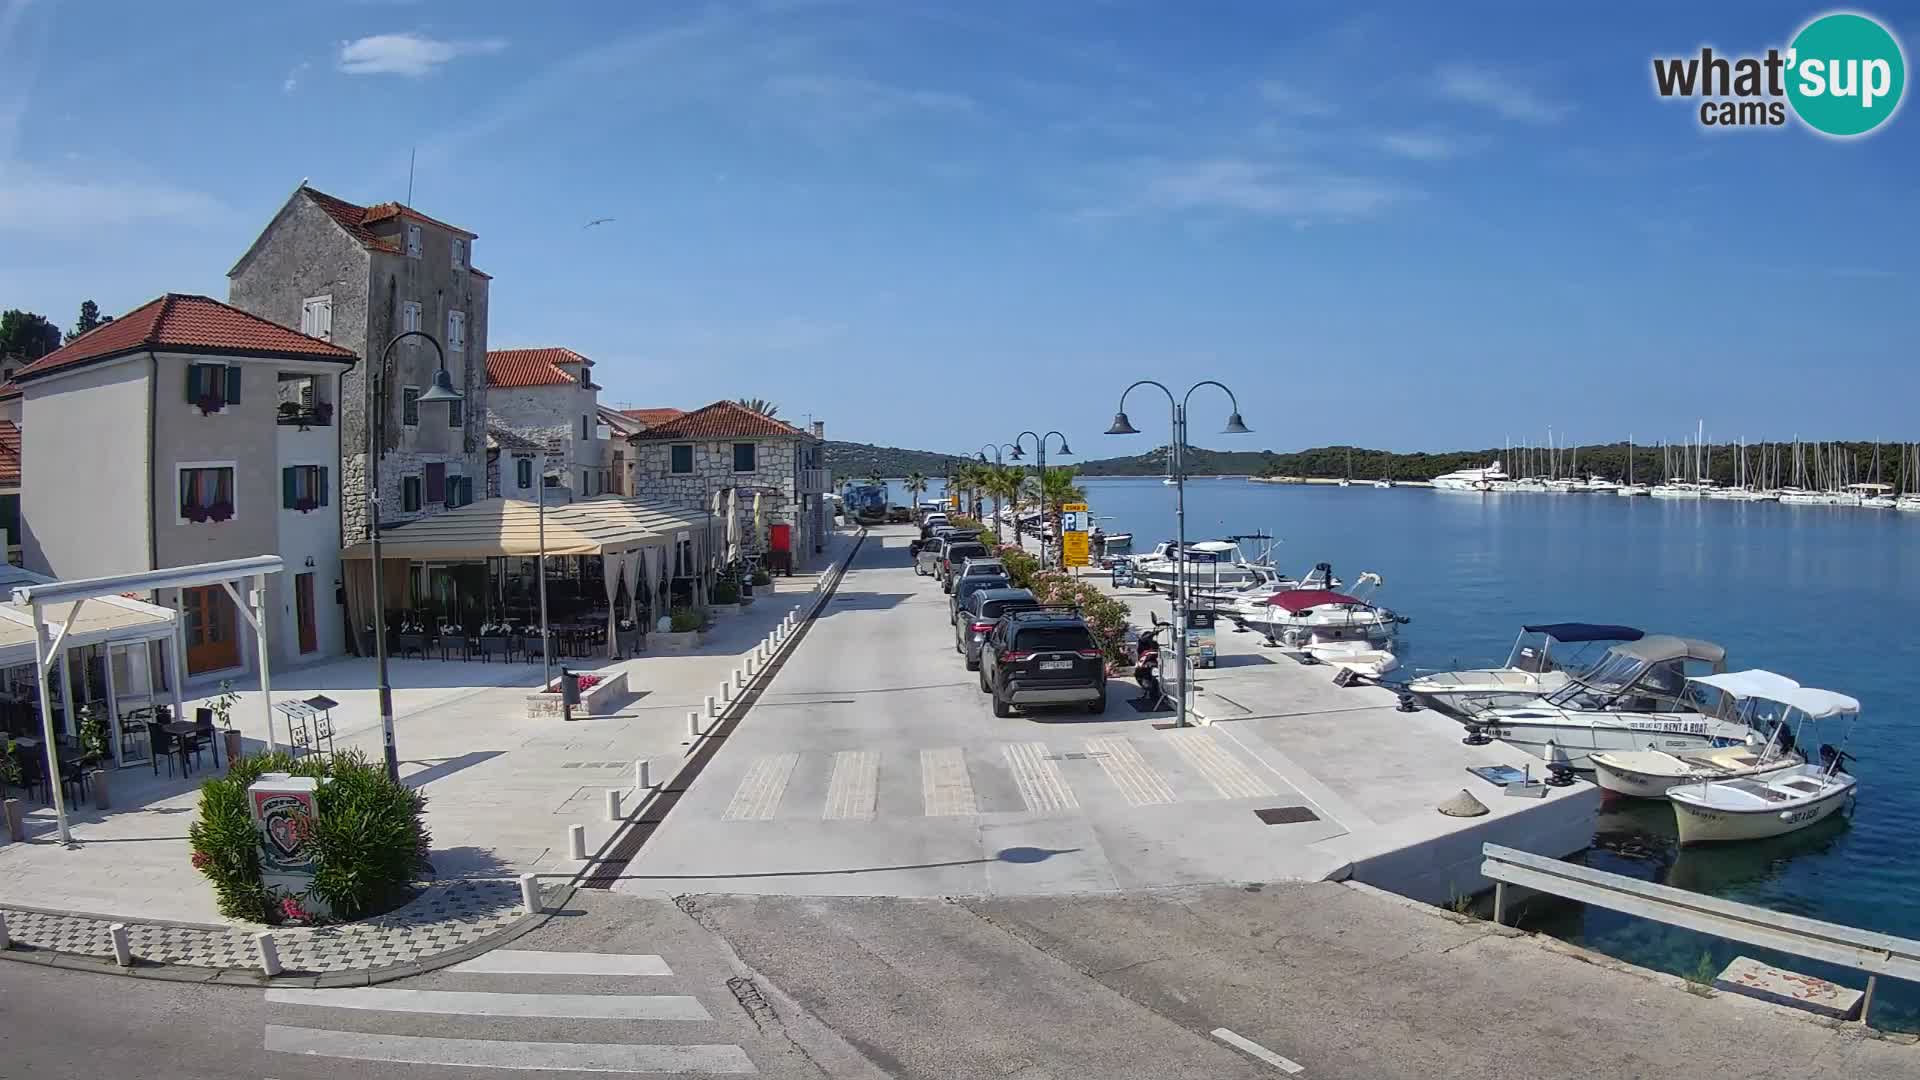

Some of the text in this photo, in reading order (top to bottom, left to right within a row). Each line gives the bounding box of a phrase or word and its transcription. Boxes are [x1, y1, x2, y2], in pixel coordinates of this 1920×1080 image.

[1065, 514, 1075, 530] P
[1663, 722, 1682, 732] RENT
[1690, 722, 1708, 734] BOAT
